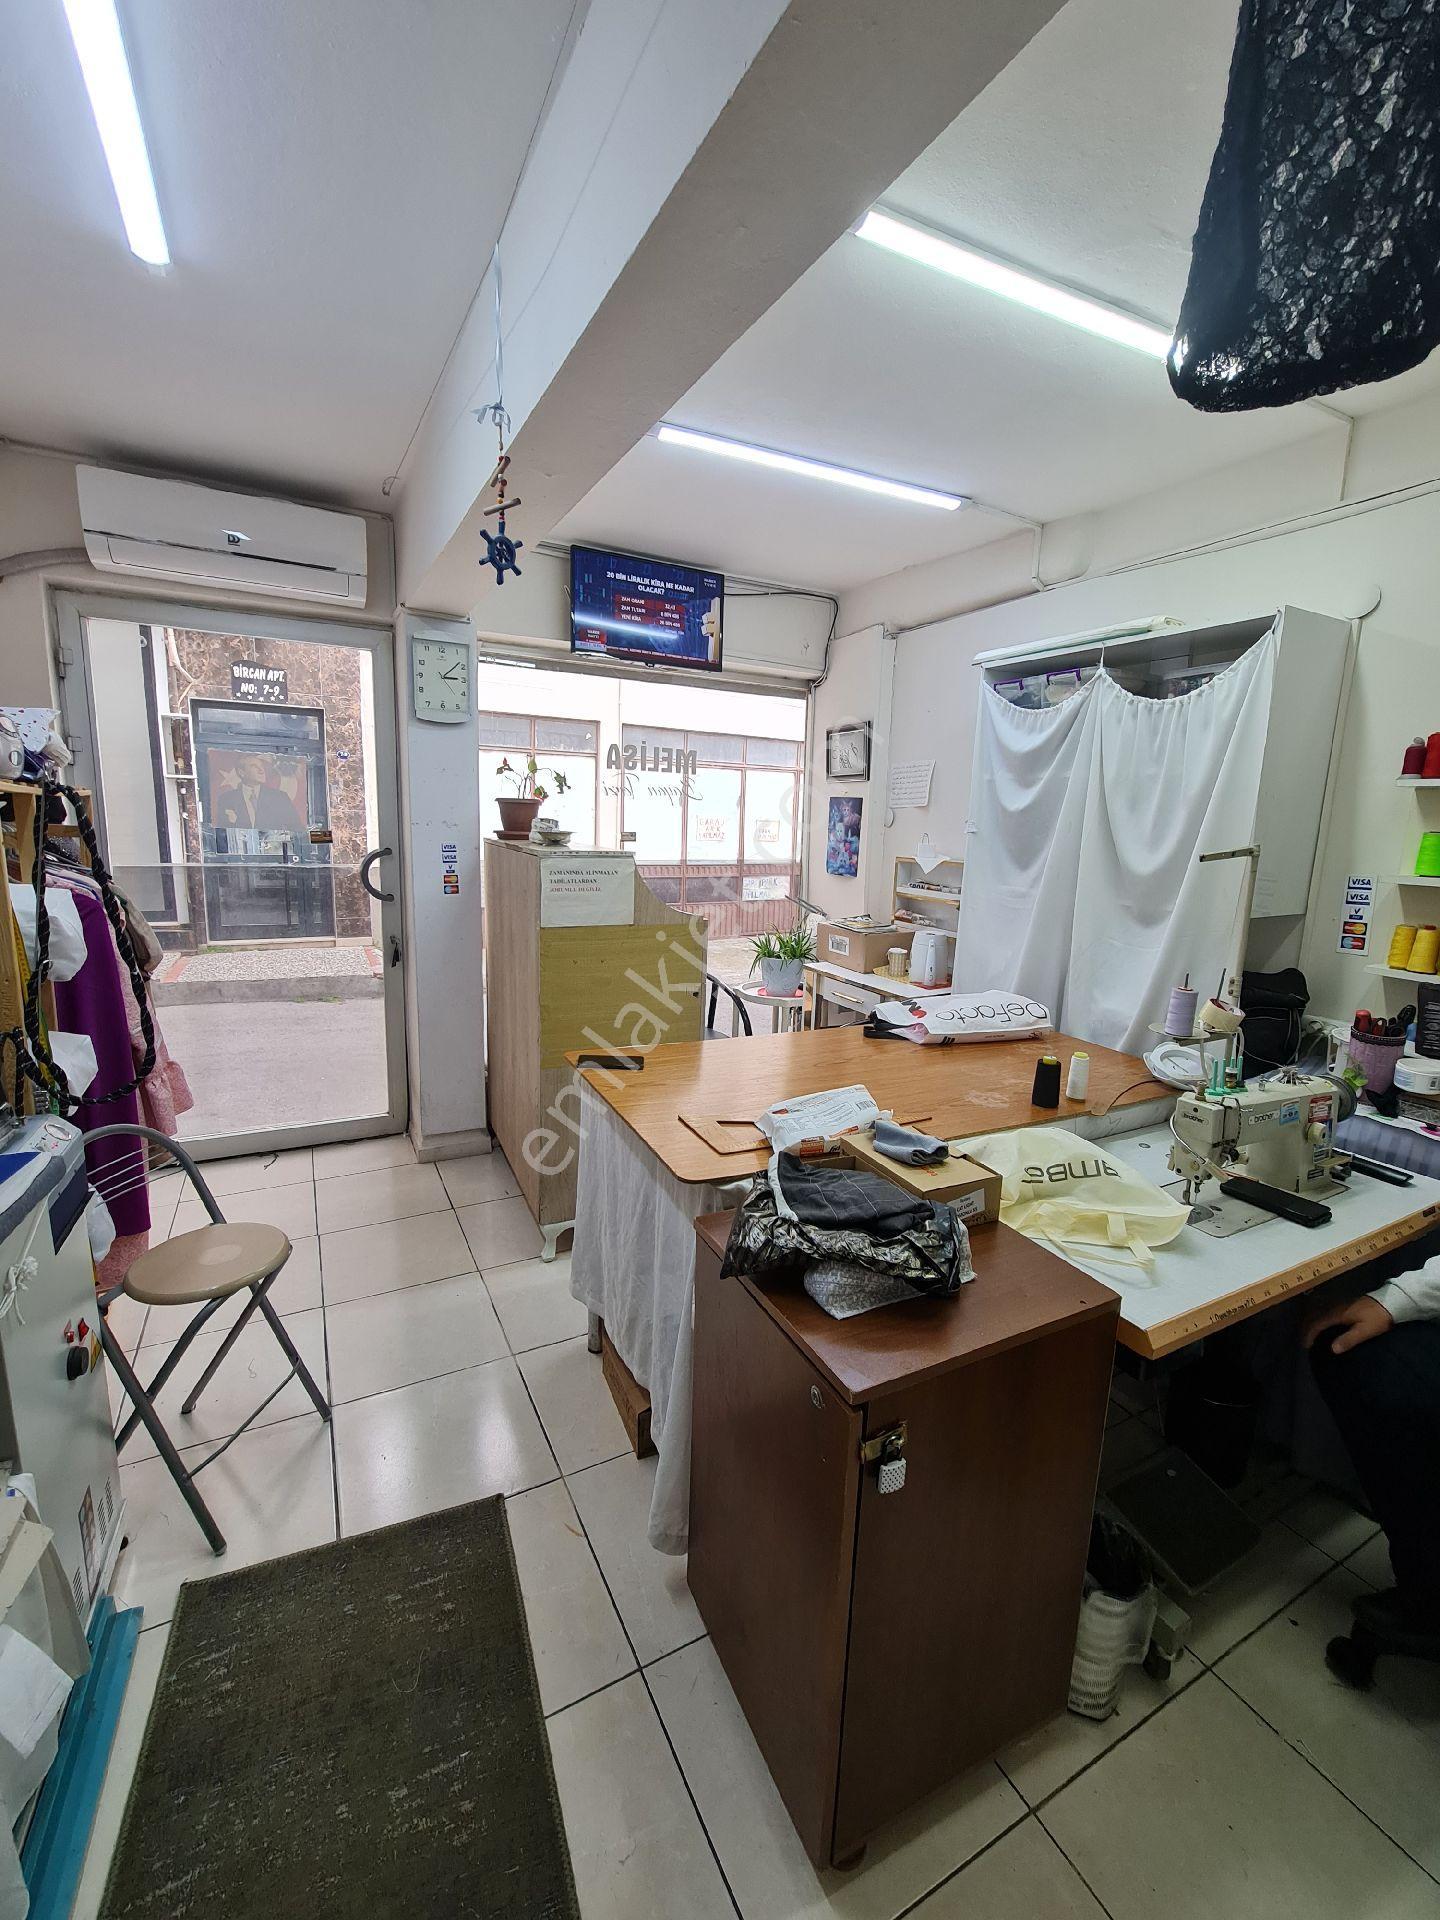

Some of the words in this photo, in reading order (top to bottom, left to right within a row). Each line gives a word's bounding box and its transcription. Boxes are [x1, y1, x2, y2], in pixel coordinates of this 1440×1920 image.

[232, 664, 266, 680] BİRCAN
[241, 682, 257, 694] NO:
[1352, 878, 1372, 886] VISA
[1350, 893, 1369, 901] VISA
[1183, 1112, 1205, 1124] brother
